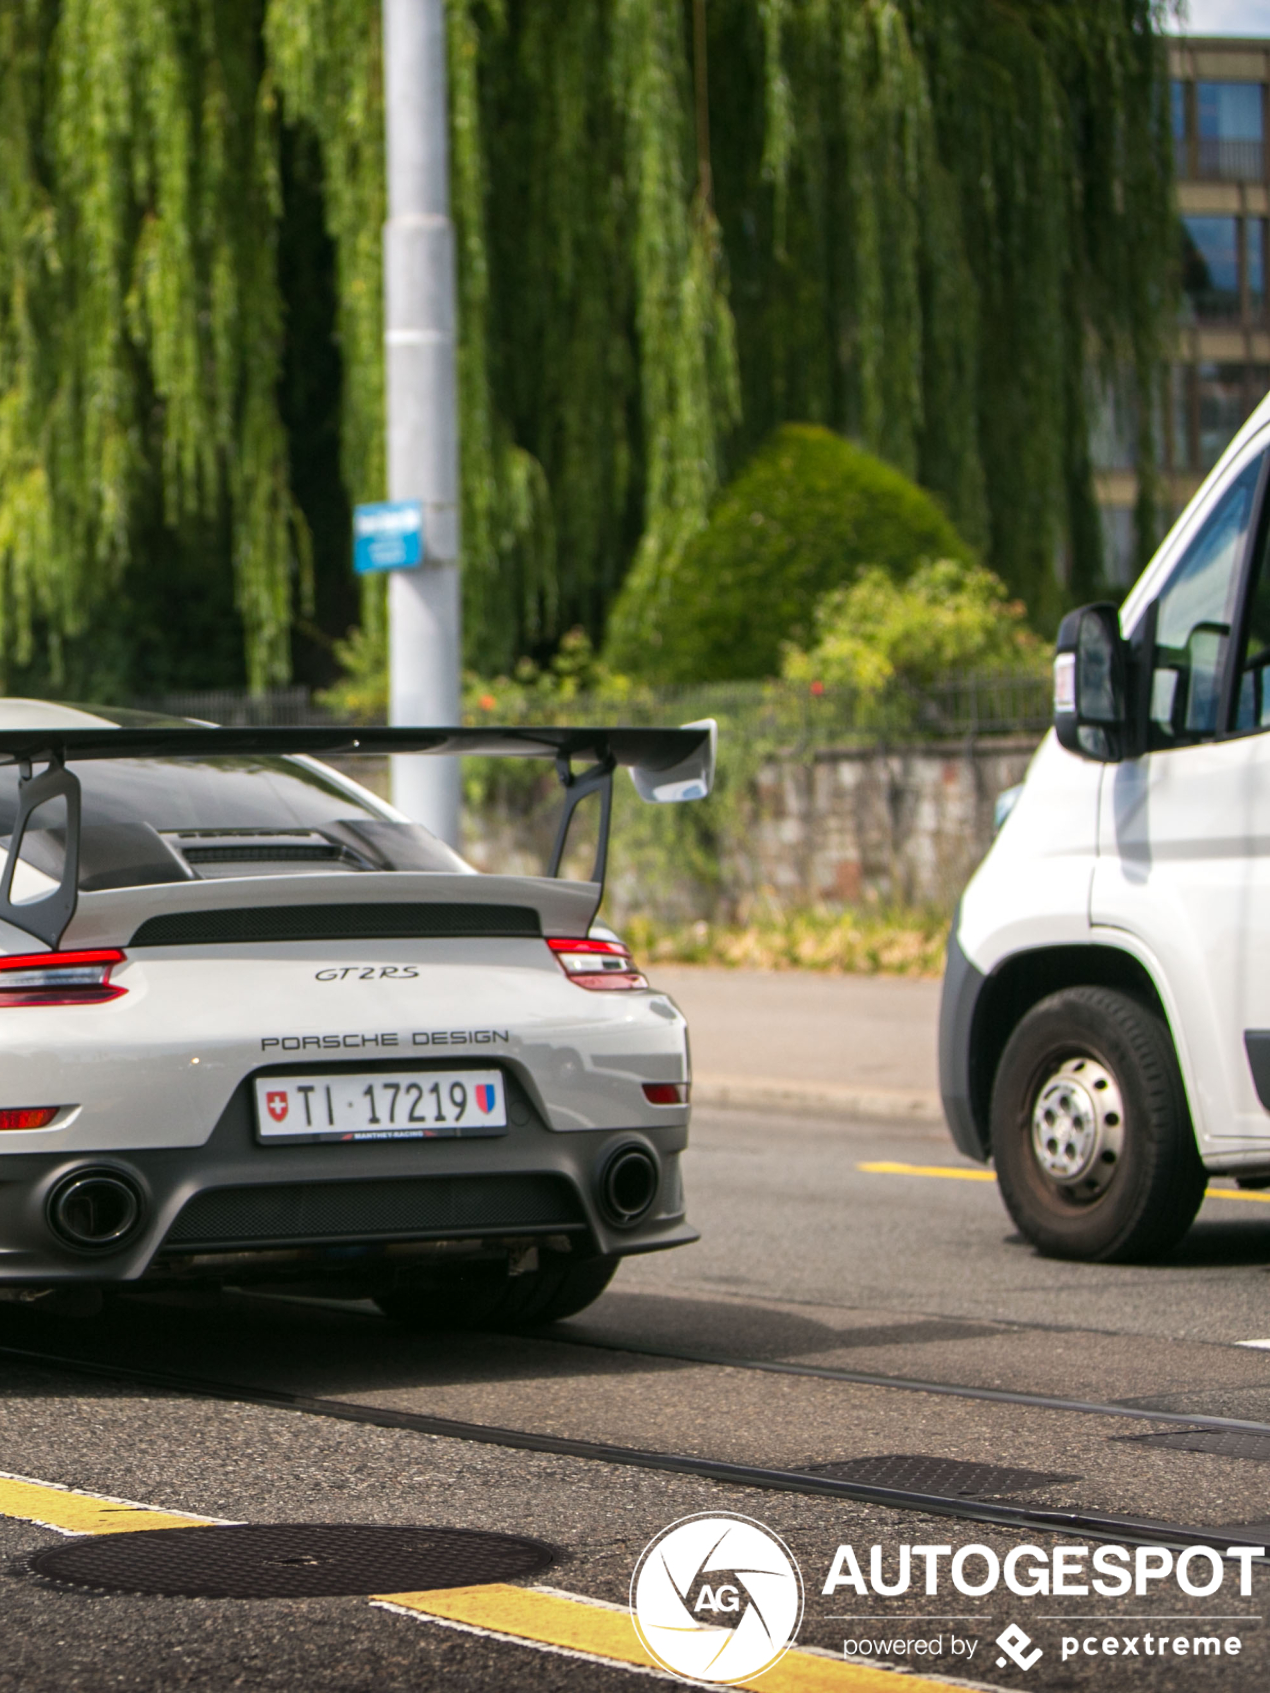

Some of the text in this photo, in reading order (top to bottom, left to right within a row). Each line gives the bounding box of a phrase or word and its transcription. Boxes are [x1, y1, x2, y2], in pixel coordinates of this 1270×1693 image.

[260, 1029, 510, 1052] PORSCHE DESIGN
[362, 1080, 469, 1125] 17219
